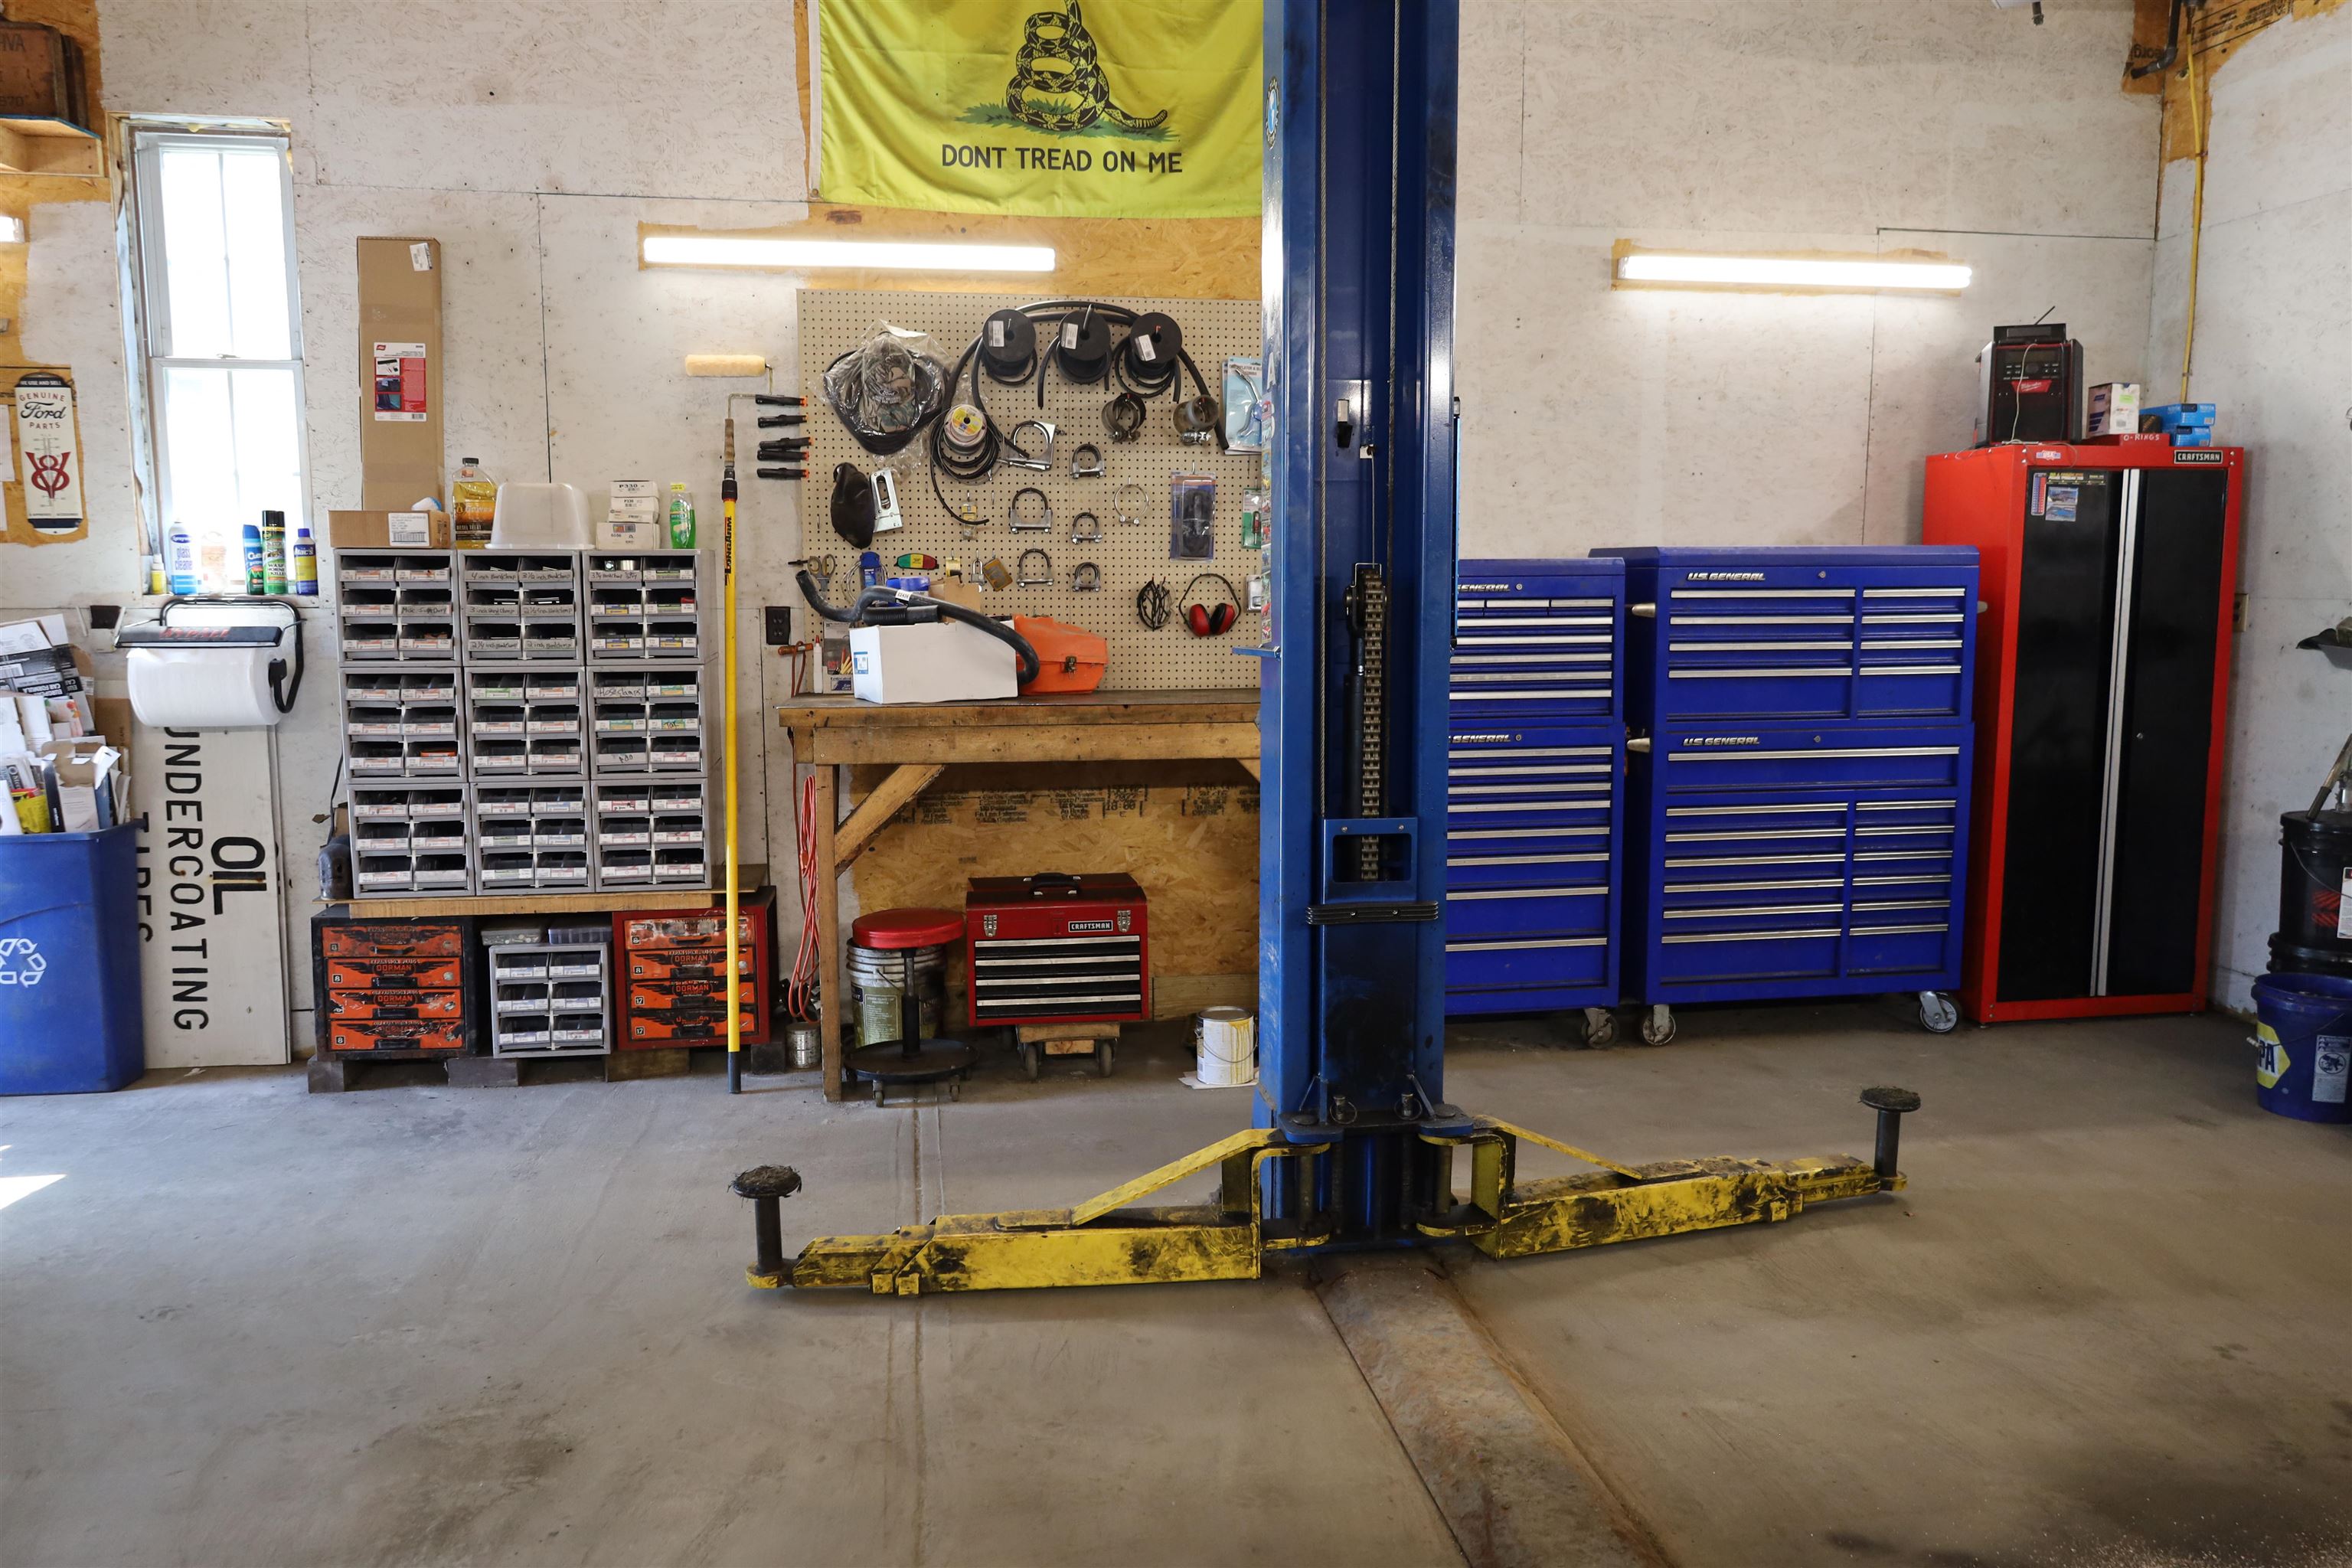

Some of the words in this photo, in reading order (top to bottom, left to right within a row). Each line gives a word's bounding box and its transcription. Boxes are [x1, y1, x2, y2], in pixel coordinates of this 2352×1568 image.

[942, 144, 1007, 169] DONT
[1015, 148, 1092, 172] TREAD
[1102, 151, 1135, 173] ON
[1148, 152, 1183, 173] ME
[19, 393, 66, 402] GENUINE
[21, 401, 67, 419] Ford
[2177, 453, 2220, 462] CRAFTSMAN
[1709, 573, 1766, 581] GENERAL
[1452, 734, 1511, 744] GENERAL
[1704, 737, 1760, 746] GENERAL
[163, 727, 209, 1031] UNDERCOATING
[211, 835, 267, 915] OIL
[1071, 922, 1111, 930] CRAFTSMAN
[635, 997, 644, 1005] 17
[636, 1027, 644, 1035] 17
